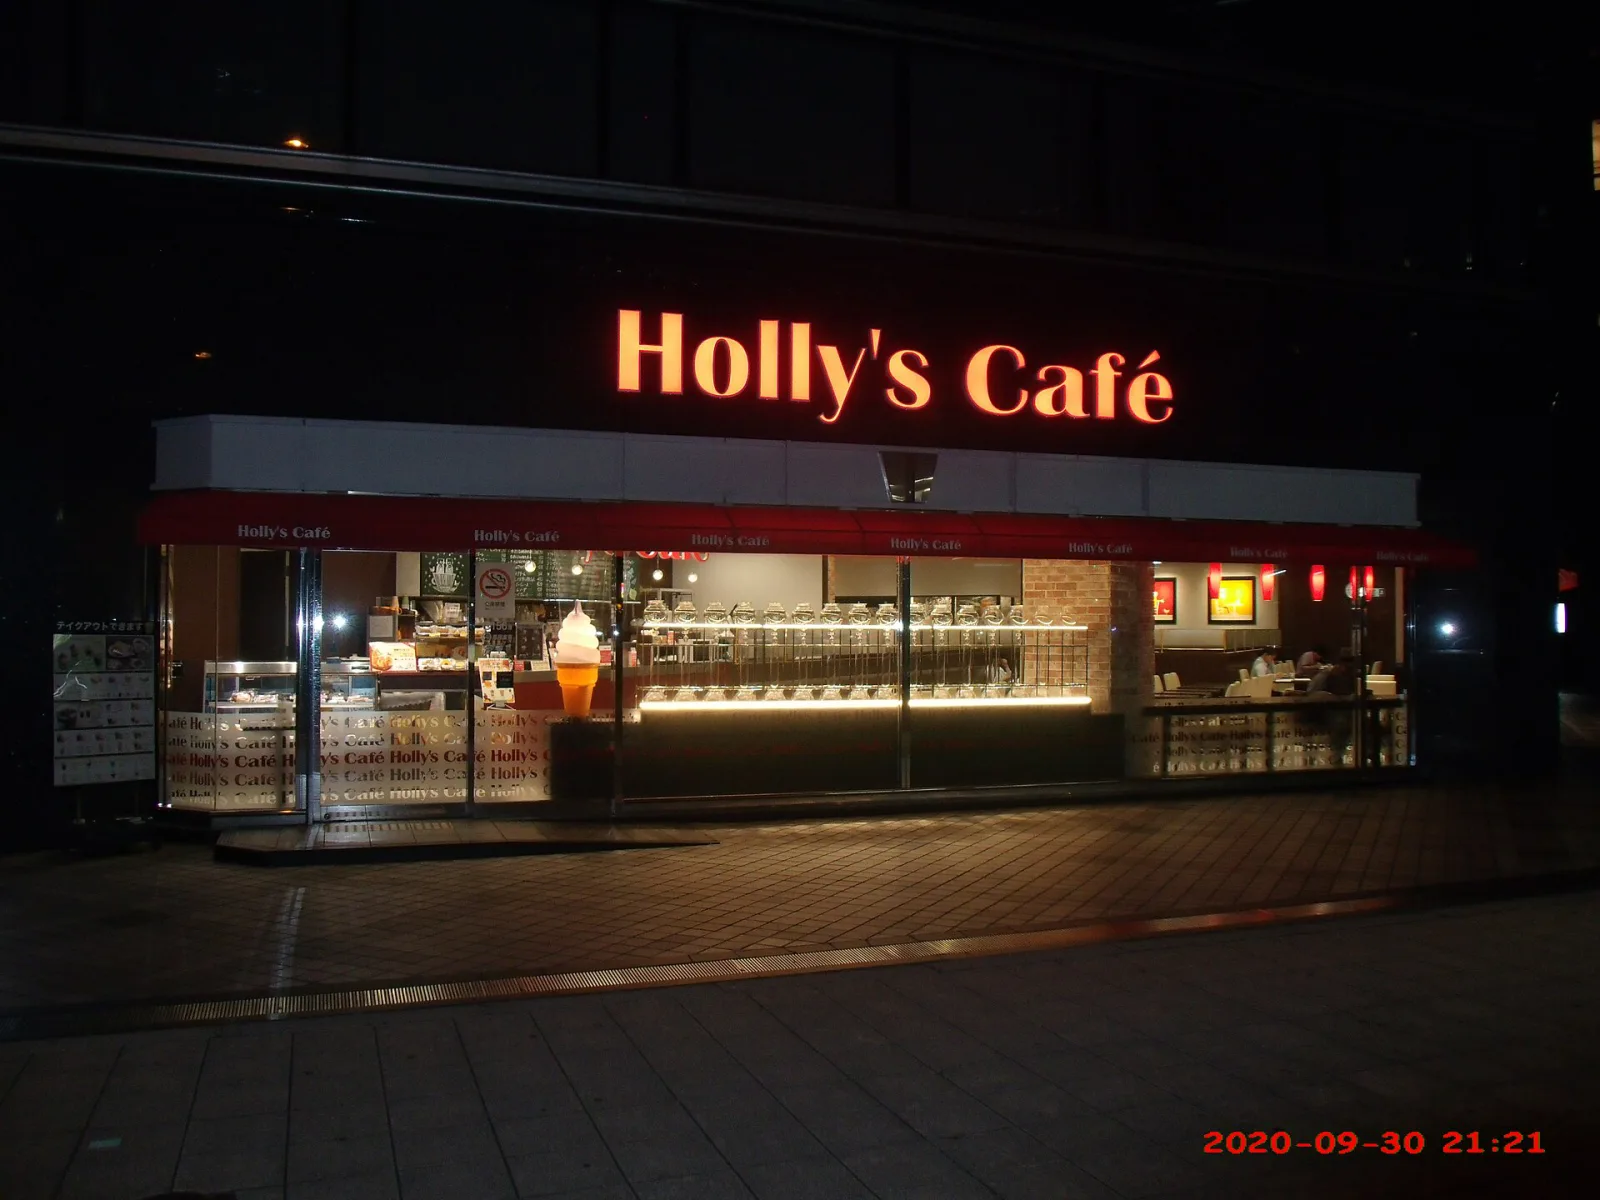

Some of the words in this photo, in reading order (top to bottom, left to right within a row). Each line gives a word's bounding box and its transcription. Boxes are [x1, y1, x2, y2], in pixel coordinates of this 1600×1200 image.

[616, 308, 932, 423] Holly's
[964, 344, 1175, 424] Café
[237, 524, 288, 540] Holly's
[292, 524, 331, 540] Café
[473, 529, 521, 544] Holly's
[524, 531, 560, 543] Café
[690, 533, 734, 547] Holly's
[737, 534, 769, 546] Café
[890, 537, 929, 550] Holly's
[932, 539, 962, 550] Café
[1068, 541, 1104, 554] Holly's
[1107, 543, 1133, 554] Café
[56, 621, 143, 632] テイクアウトできます
[169, 716, 187, 730] afé
[169, 735, 187, 748] afé
[344, 733, 385, 747] Café
[168, 753, 187, 766] afé
[189, 753, 229, 769] Holly's
[234, 754, 276, 768] Café
[344, 750, 385, 765] Café
[390, 750, 439, 766] Holly's
[491, 749, 538, 765] Holly's
[234, 773, 276, 786] Café
[344, 768, 385, 782] Café
[390, 768, 439, 784] Holly's
[491, 767, 538, 782] Holly's
[234, 790, 277, 805] Café
[344, 786, 385, 801] Café
[390, 785, 439, 801] Holly's
